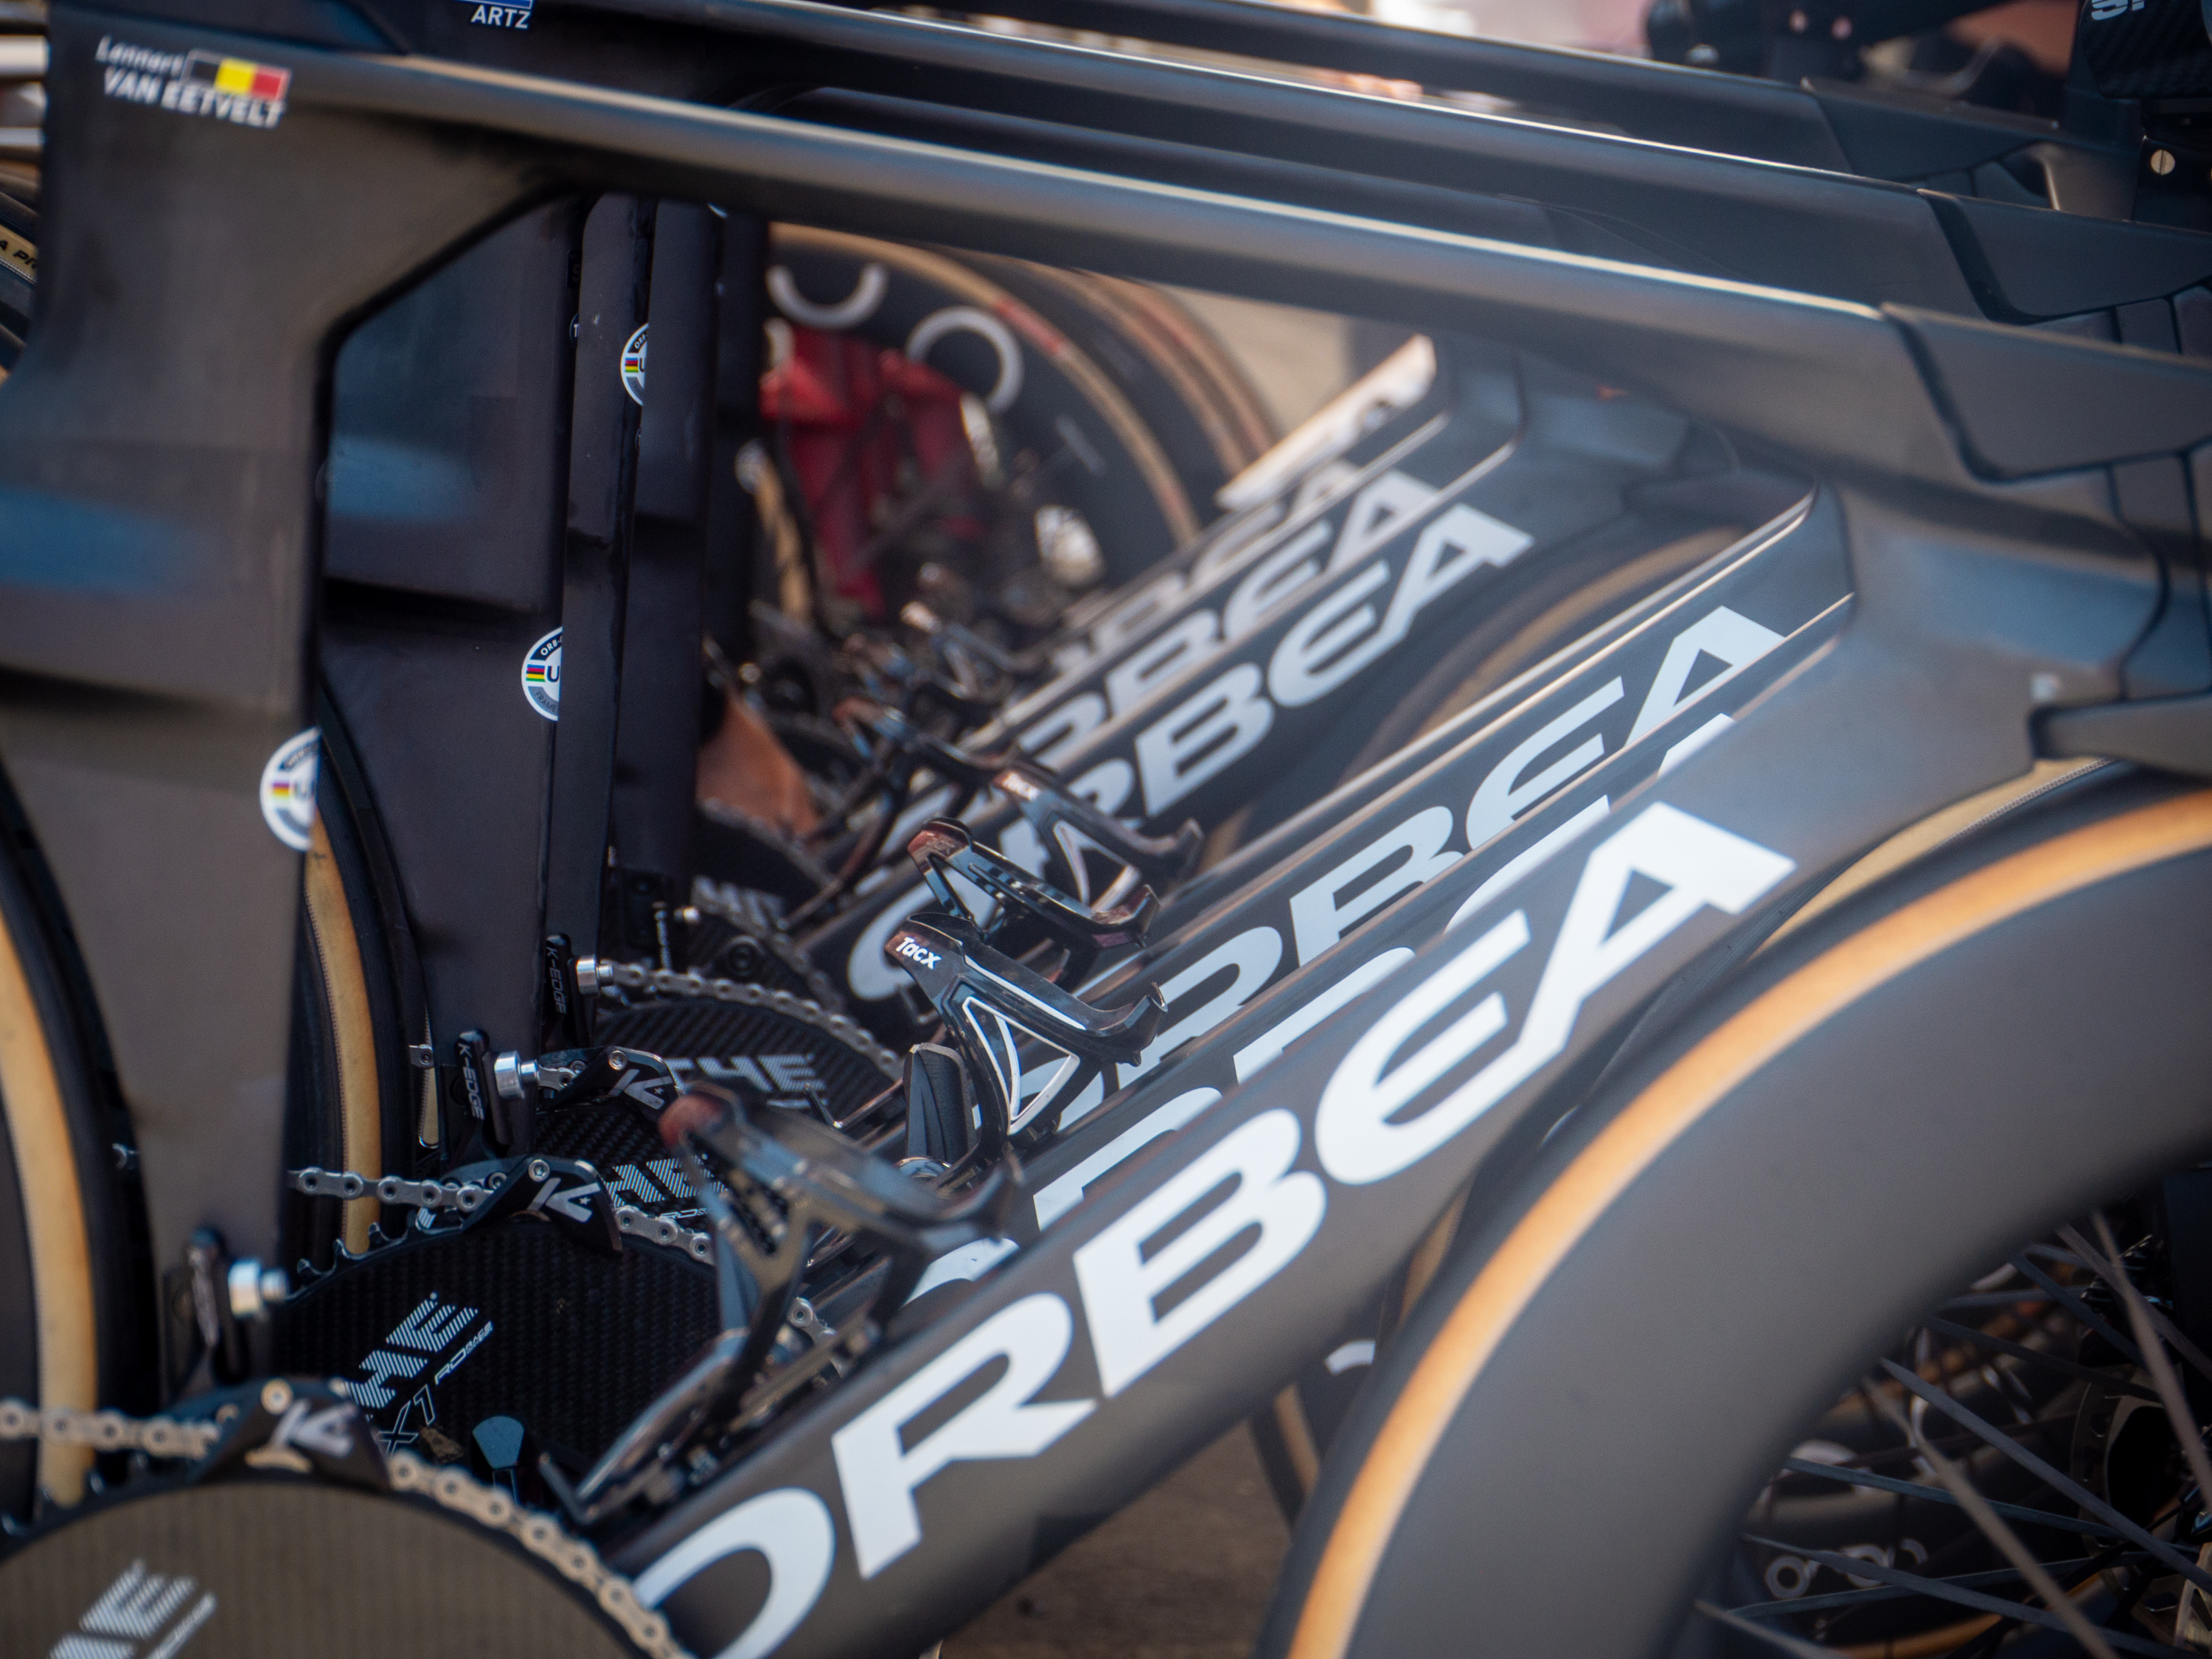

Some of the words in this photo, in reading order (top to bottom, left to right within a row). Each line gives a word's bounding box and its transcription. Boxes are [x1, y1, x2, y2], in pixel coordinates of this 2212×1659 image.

[470, 4, 531, 29] ARTZ
[104, 65, 162, 104] VAN
[895, 936, 942, 970] Tacx
[546, 946, 567, 1015] K-EDGE
[458, 1042, 484, 1120] K-EDGE
